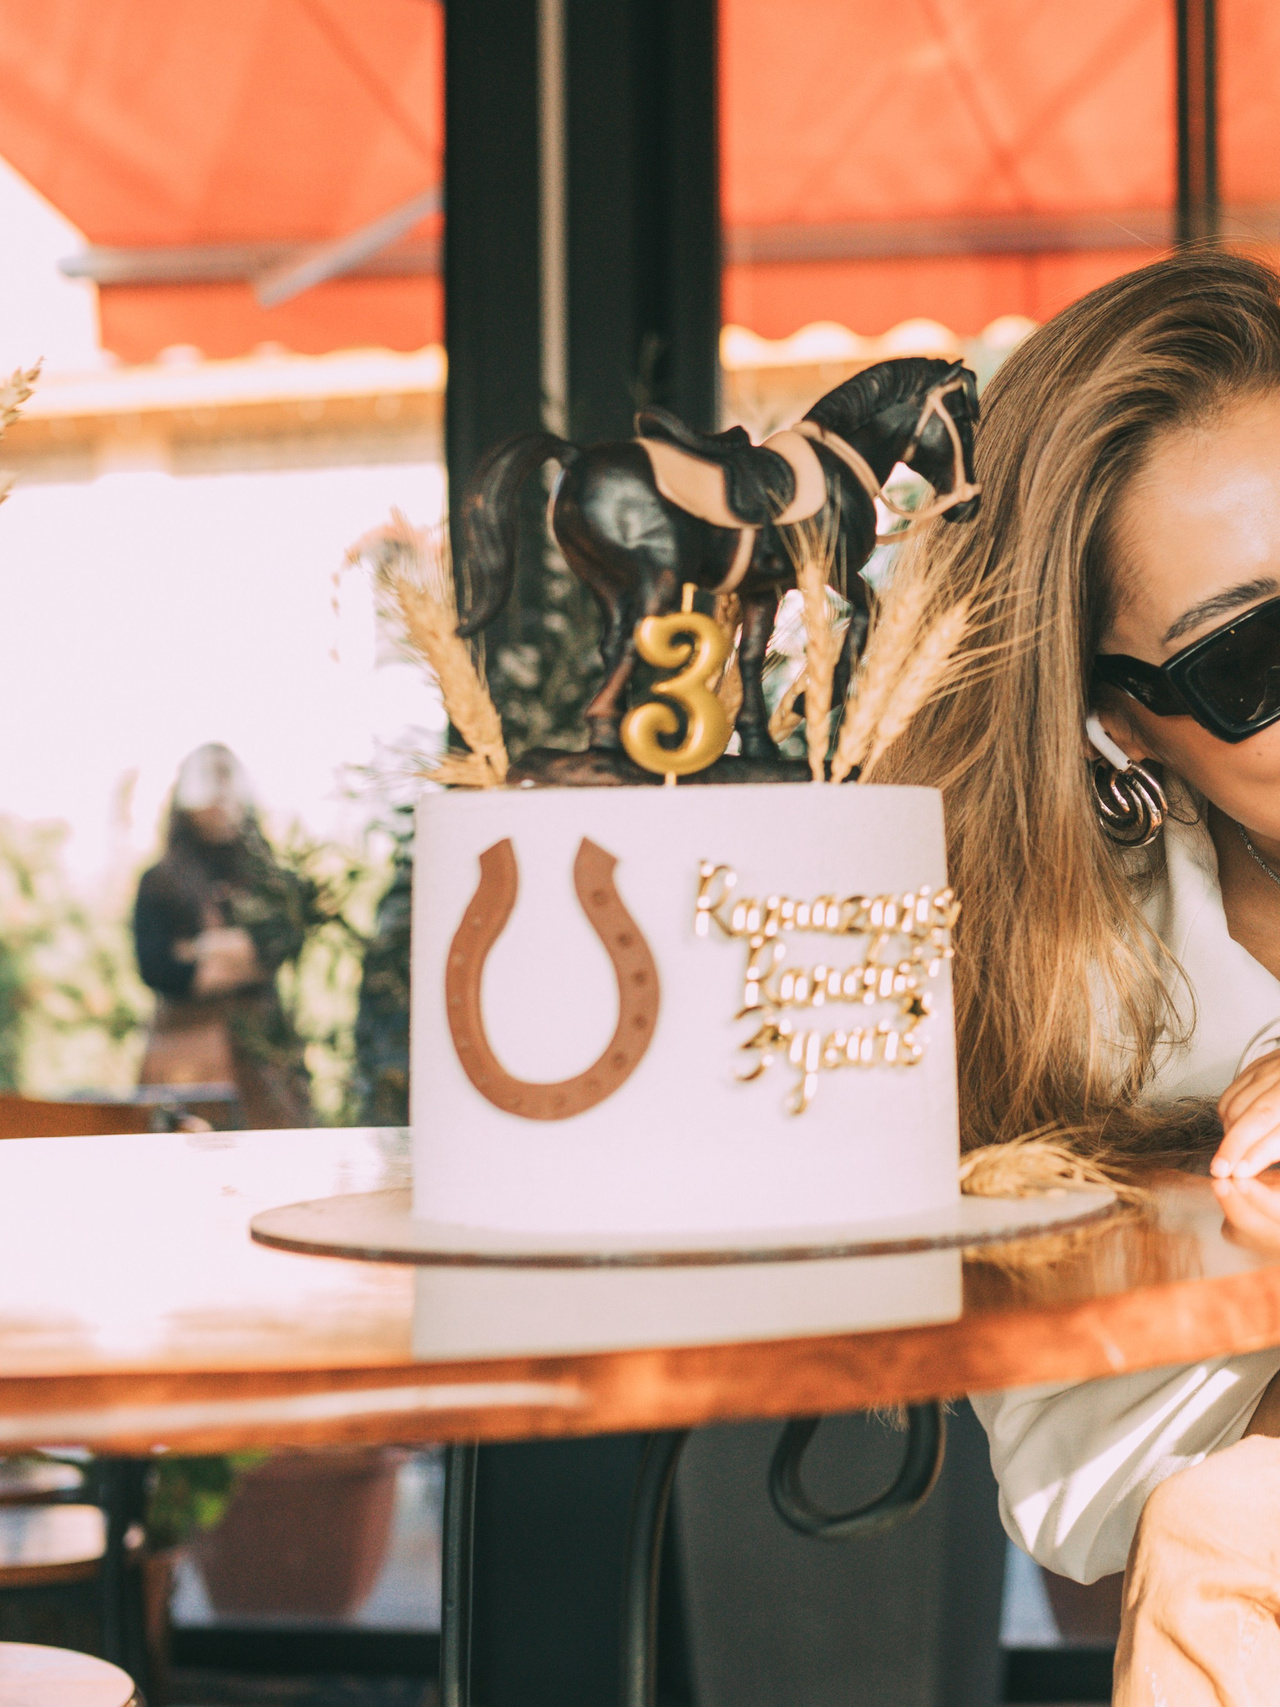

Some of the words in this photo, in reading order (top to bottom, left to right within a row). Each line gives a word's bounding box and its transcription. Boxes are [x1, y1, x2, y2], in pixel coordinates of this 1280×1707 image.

[620, 612, 732, 776] 3
[733, 1005, 774, 1082] 3
[785, 1022, 925, 1116] years
